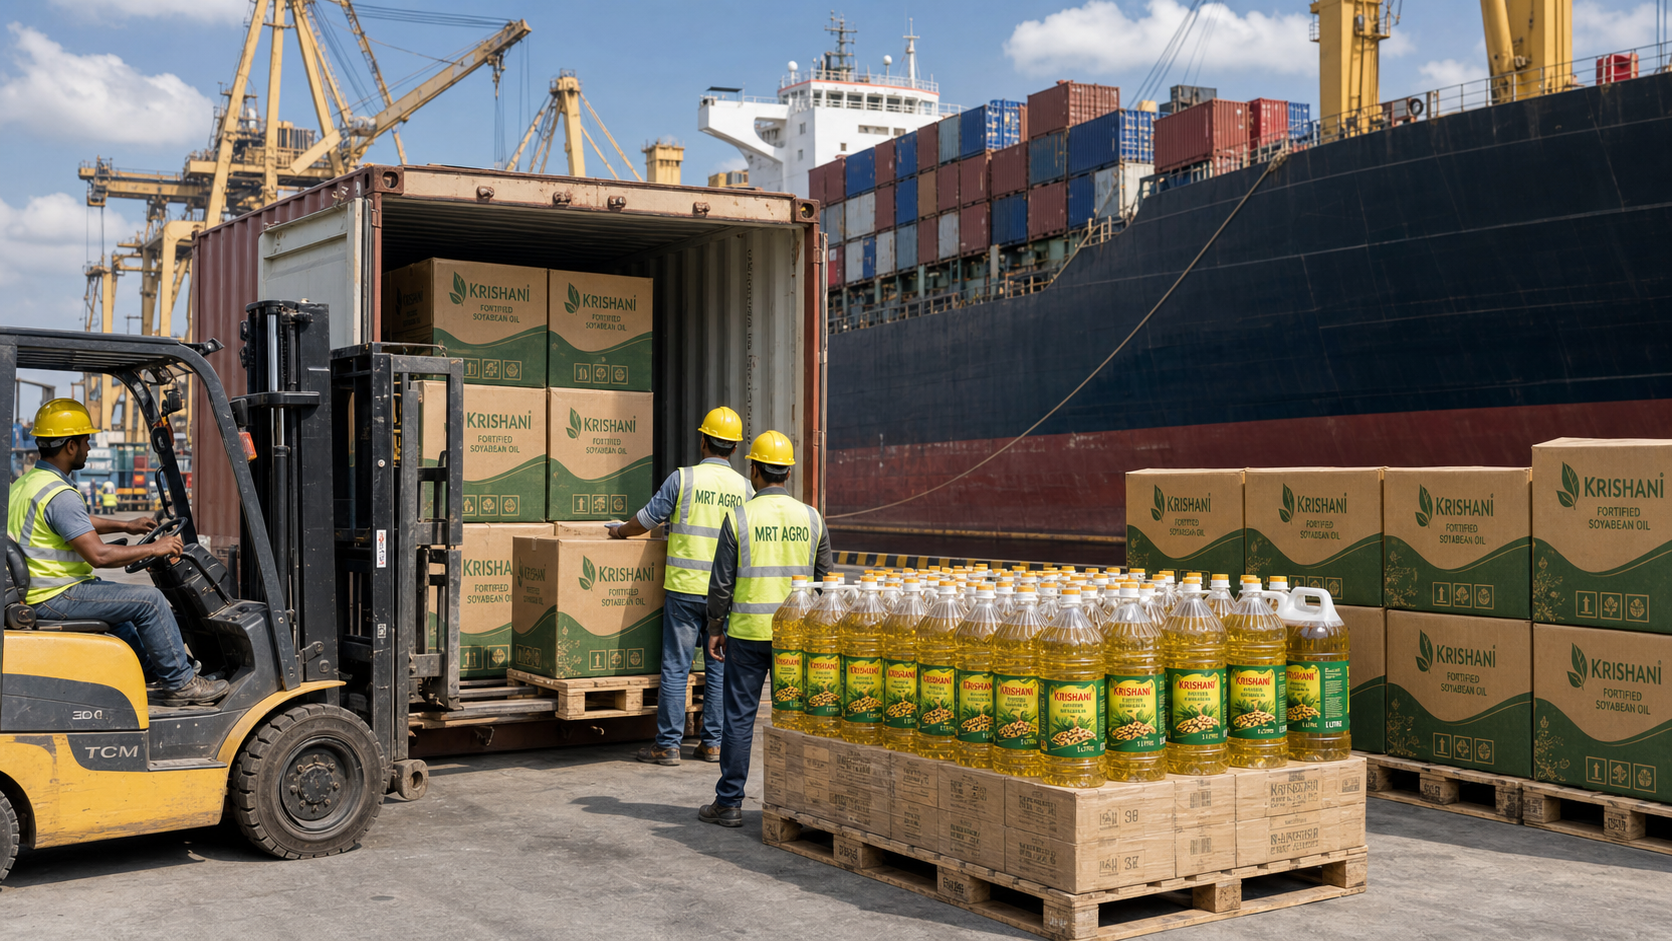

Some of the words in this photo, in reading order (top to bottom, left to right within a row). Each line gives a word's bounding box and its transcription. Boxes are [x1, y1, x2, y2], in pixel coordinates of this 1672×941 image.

[509, 445, 520, 453] OIL
[695, 489, 716, 505] MRT
[718, 493, 742, 508] AGRO
[1597, 507, 1640, 517] FORTIFIED
[1589, 519, 1634, 530] SOYABEAN
[1637, 520, 1650, 530] OIL
[755, 526, 778, 542] MRT
[782, 526, 809, 542] AGRO
[1475, 536, 1485, 545] OIL
[1179, 681, 1215, 689] KRISHANI
[1114, 687, 1150, 696] KRISHANI
[1604, 688, 1642, 701] FORTIFIED
[1596, 700, 1636, 713] SOYABEAN
[1638, 703, 1650, 715] OIL
[85, 746, 138, 759] TCM
